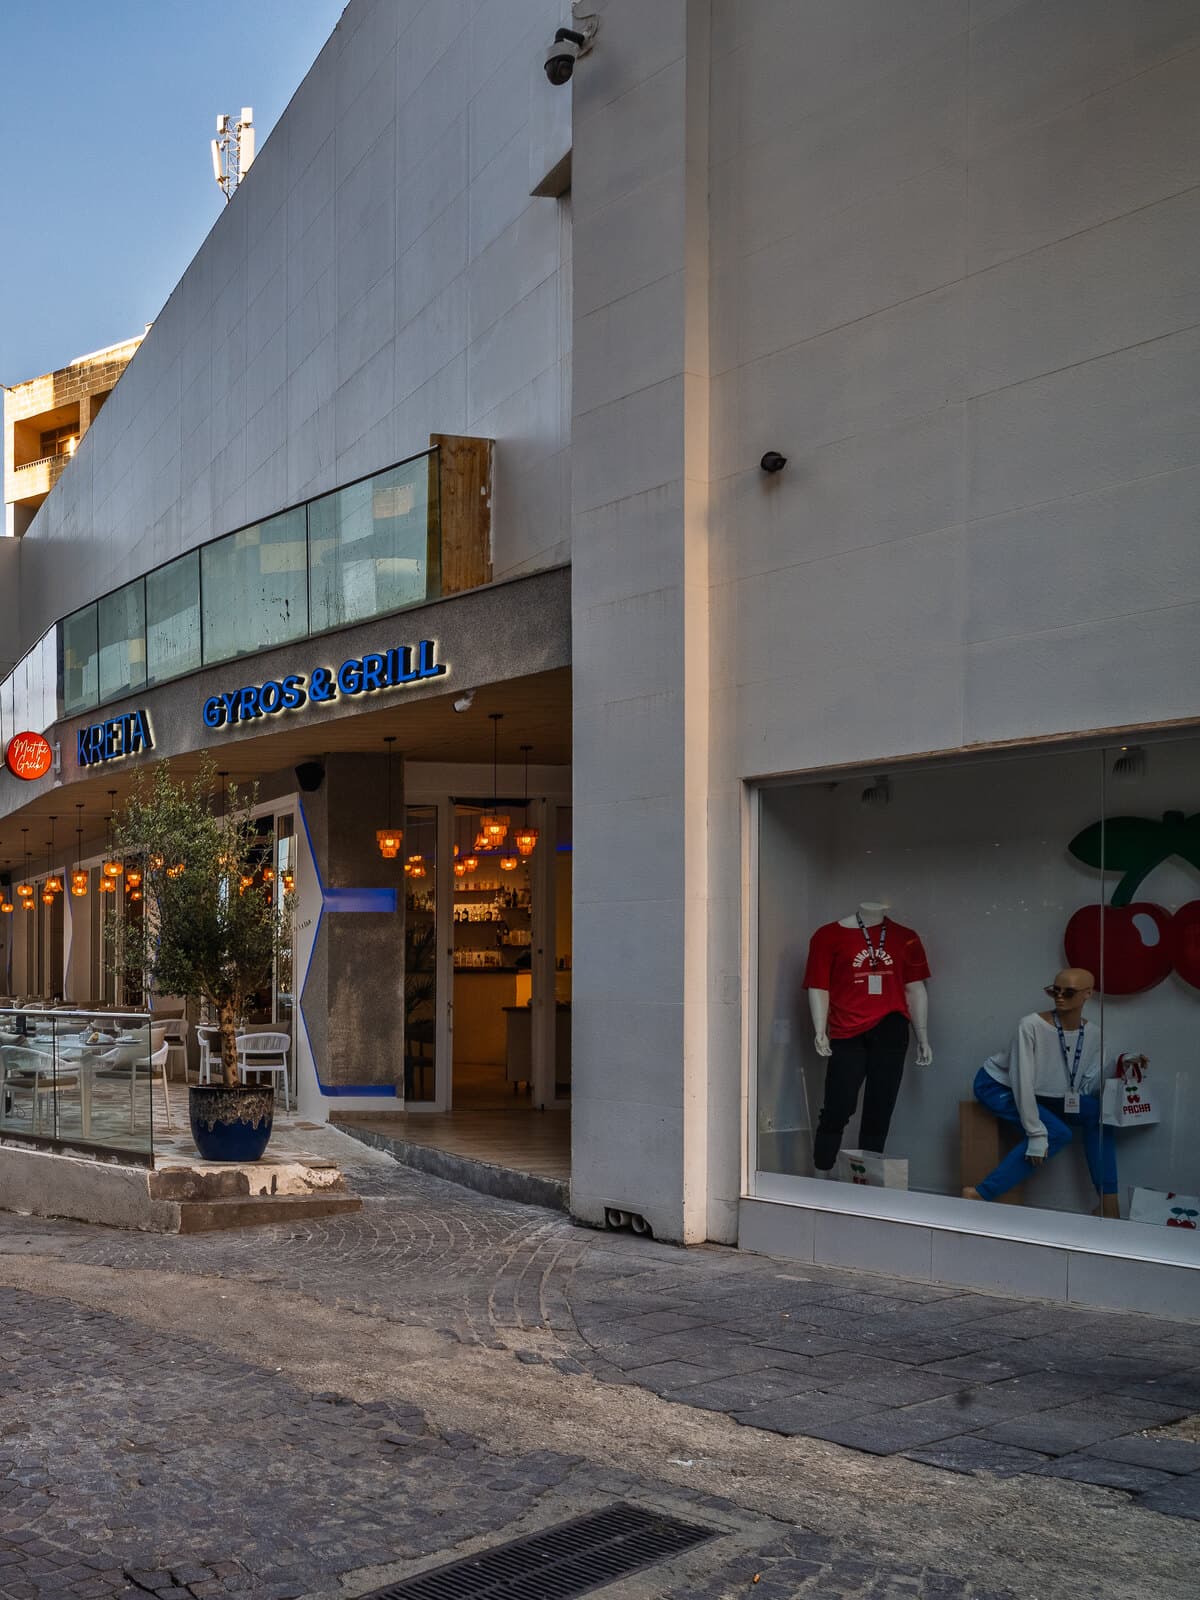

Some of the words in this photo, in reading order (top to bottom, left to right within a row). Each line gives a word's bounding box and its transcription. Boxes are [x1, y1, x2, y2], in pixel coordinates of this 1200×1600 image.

[203, 675, 305, 727] GYROS
[308, 667, 336, 702] &
[338, 640, 447, 695] GRILL
[77, 710, 153, 767] KRETA
[14, 739, 36, 759] Meet
[852, 949, 869, 968] SINC
[1123, 1104, 1150, 1115] PACHA
